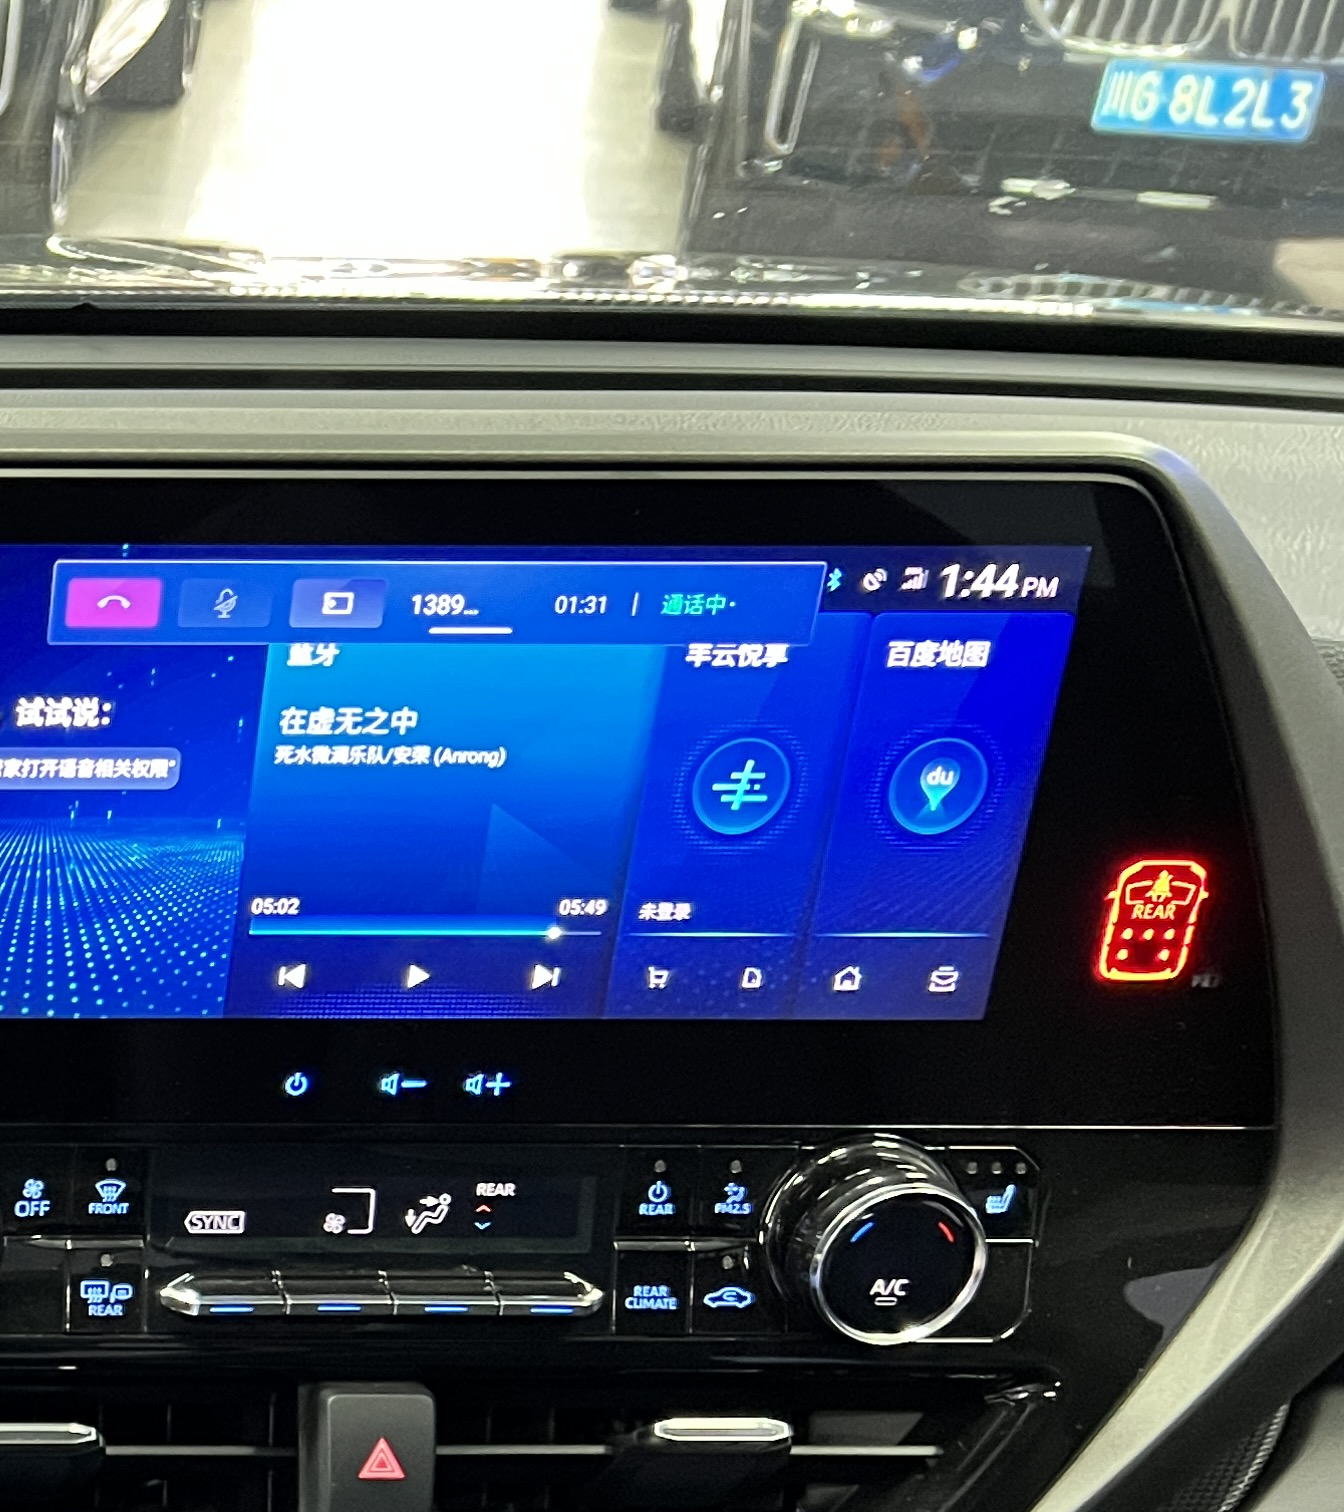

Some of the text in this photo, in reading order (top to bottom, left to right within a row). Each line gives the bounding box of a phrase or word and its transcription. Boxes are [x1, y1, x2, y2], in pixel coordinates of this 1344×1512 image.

[940, 564, 1059, 599] 1:44 PM
[555, 595, 607, 615] 01:31
[887, 640, 991, 668] 百度地图
[279, 706, 418, 735] 在虚无之中
[251, 897, 300, 916] 05:02
[559, 897, 608, 916] 05:49
[1132, 904, 1175, 921] REAR
[476, 1182, 516, 1197] REAR
[14, 1201, 51, 1217] OFF
[88, 1202, 129, 1215] FRONT
[639, 1203, 674, 1215] REAR
[190, 1215, 240, 1231] SYNC
[633, 1285, 667, 1297] REAR
[870, 1279, 909, 1297] A/C
[88, 1304, 123, 1317] REAR
[625, 1297, 677, 1310] CLIMATE
